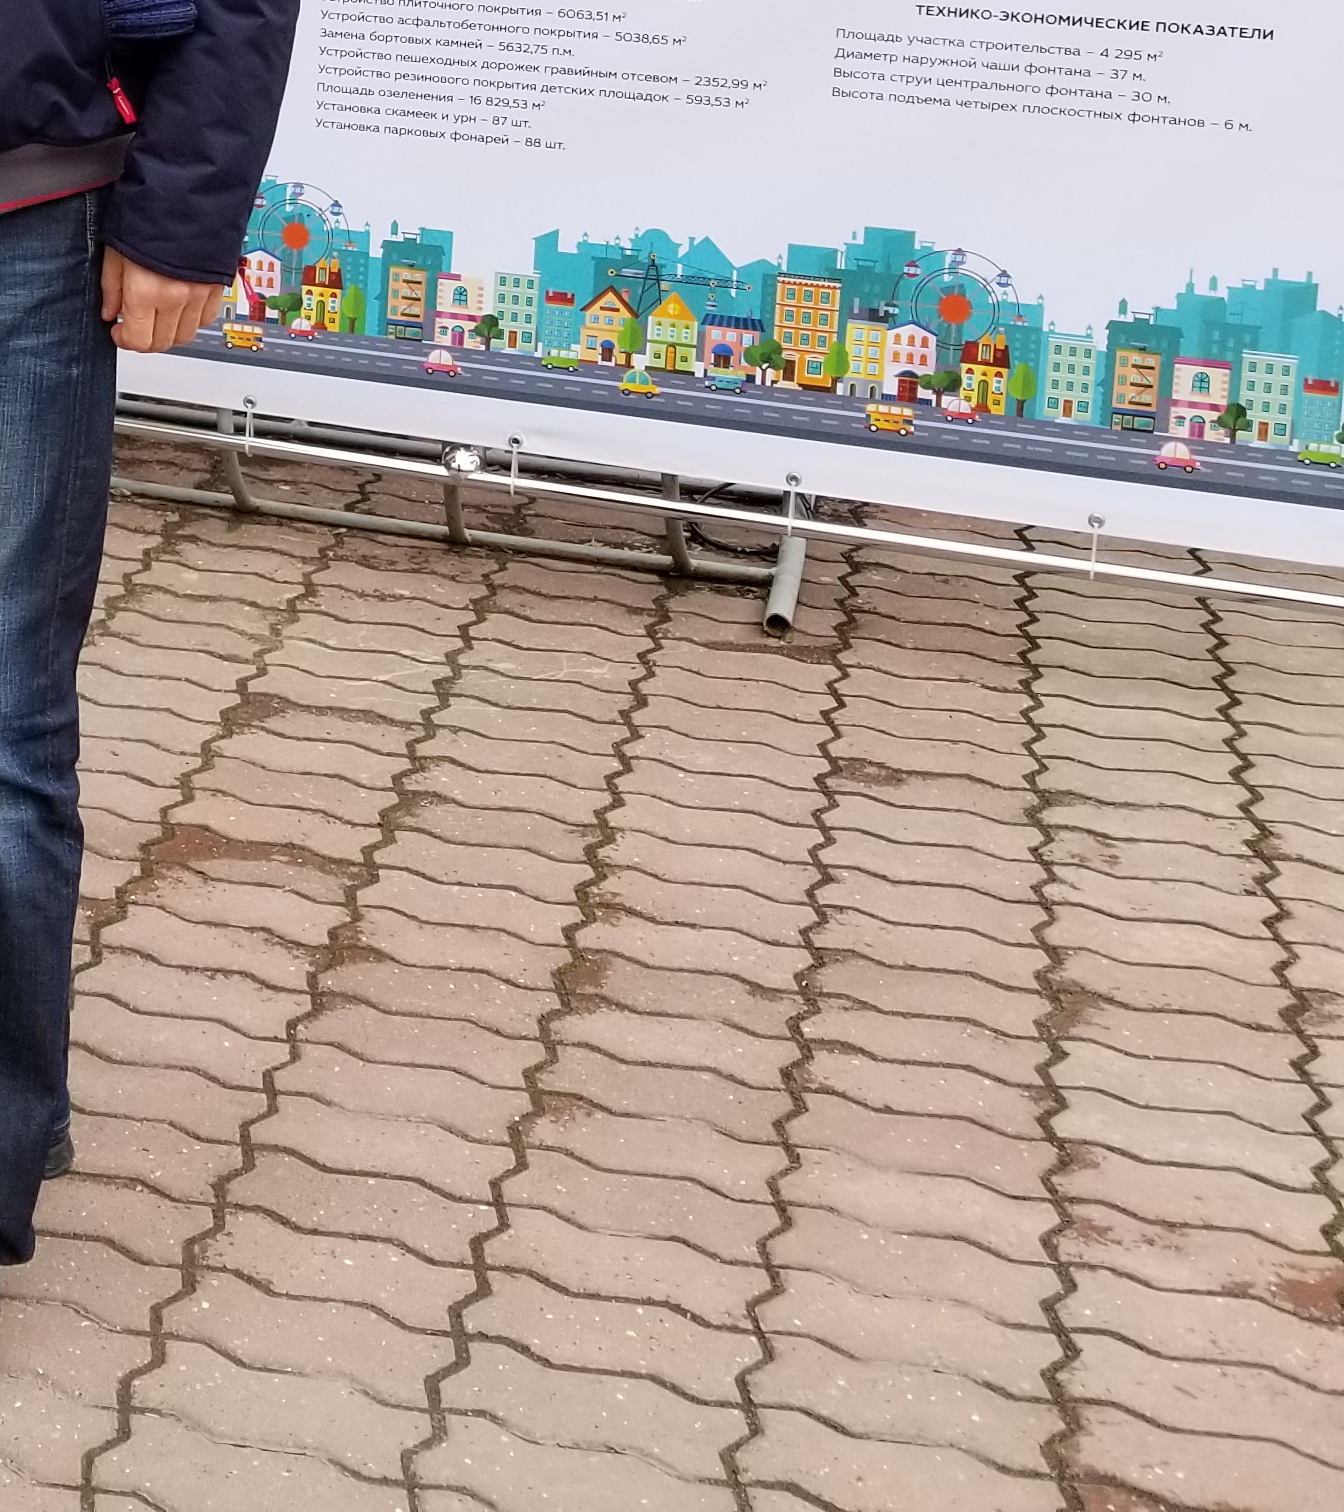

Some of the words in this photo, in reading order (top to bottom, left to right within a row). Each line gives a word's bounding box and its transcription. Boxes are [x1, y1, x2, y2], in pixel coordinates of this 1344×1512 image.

[320, 9, 394, 24] Устройство
[396, 15, 530, 34] асфальтобетонного
[533, 27, 598, 39] покрытия
[614, 31, 668, 44] 5038,65
[477, 4, 541, 16] покрытия
[557, 8, 608, 21] 6063,51
[914, 4, 1150, 31] ТЕХНИКО-ЭКОНОМИЧЕСКИЕ
[1155, 21, 1274, 40] ПОКАЗАТЕЛИ
[319, 27, 365, 40] Замена
[369, 30, 432, 45] бортовых
[435, 38, 482, 49] камней
[497, 41, 548, 54] 5632,75
[551, 47, 575, 57] п.м.
[835, 27, 903, 43] Площадь
[906, 35, 965, 47] участка
[969, 40, 1081, 56] строительства
[1099, 47, 1109, 57] 4
[1113, 48, 1142, 60] 295
[318, 45, 392, 60] Устройство
[395, 53, 477, 67] пешеходных
[480, 60, 540, 73] дорожек
[543, 65, 617, 79] гравийным
[620, 72, 677, 83] отсевом
[693, 75, 748, 89] 2352,99
[834, 47, 898, 64] Диаметр
[902, 54, 977, 69] наружной
[981, 60, 1019, 72] чаши
[1023, 62, 1092, 77] фонтана
[1109, 68, 1128, 79] 37
[1132, 72, 1146, 81] м.
[316, 81, 375, 97] Площадь
[377, 89, 453, 102] озеленения
[468, 95, 482, 105] 16
[485, 96, 528, 109] 829,53
[317, 63, 390, 78] Устройство
[394, 72, 469, 85] резинового
[472, 78, 536, 91] покрытия
[539, 84, 595, 96] детских
[598, 89, 669, 102] площадок
[685, 94, 730, 107] 593,53
[833, 67, 886, 81] Высота
[889, 73, 932, 86] струи
[936, 77, 1041, 93] центрального
[1045, 83, 1113, 99] фонтана
[1130, 90, 1152, 102] 30
[1156, 95, 1170, 103] м.
[315, 99, 381, 114] Установка
[384, 107, 438, 119] скамеек
[441, 112, 449, 121] и
[452, 113, 476, 124] урн
[491, 115, 508, 125] 87
[510, 118, 531, 128] шт.
[831, 86, 884, 100] Высота
[888, 93, 951, 106] подъема
[955, 98, 1018, 112] четырех
[1022, 104, 1123, 120] плоскостных
[1127, 110, 1205, 127] фонтанов
[1224, 119, 1233, 129] 6
[1238, 122, 1252, 131] м.
[314, 117, 380, 132] Установка
[383, 125, 446, 139] парковых
[449, 130, 509, 145] фонарей
[524, 137, 541, 147] 88
[545, 140, 565, 150] шт.
